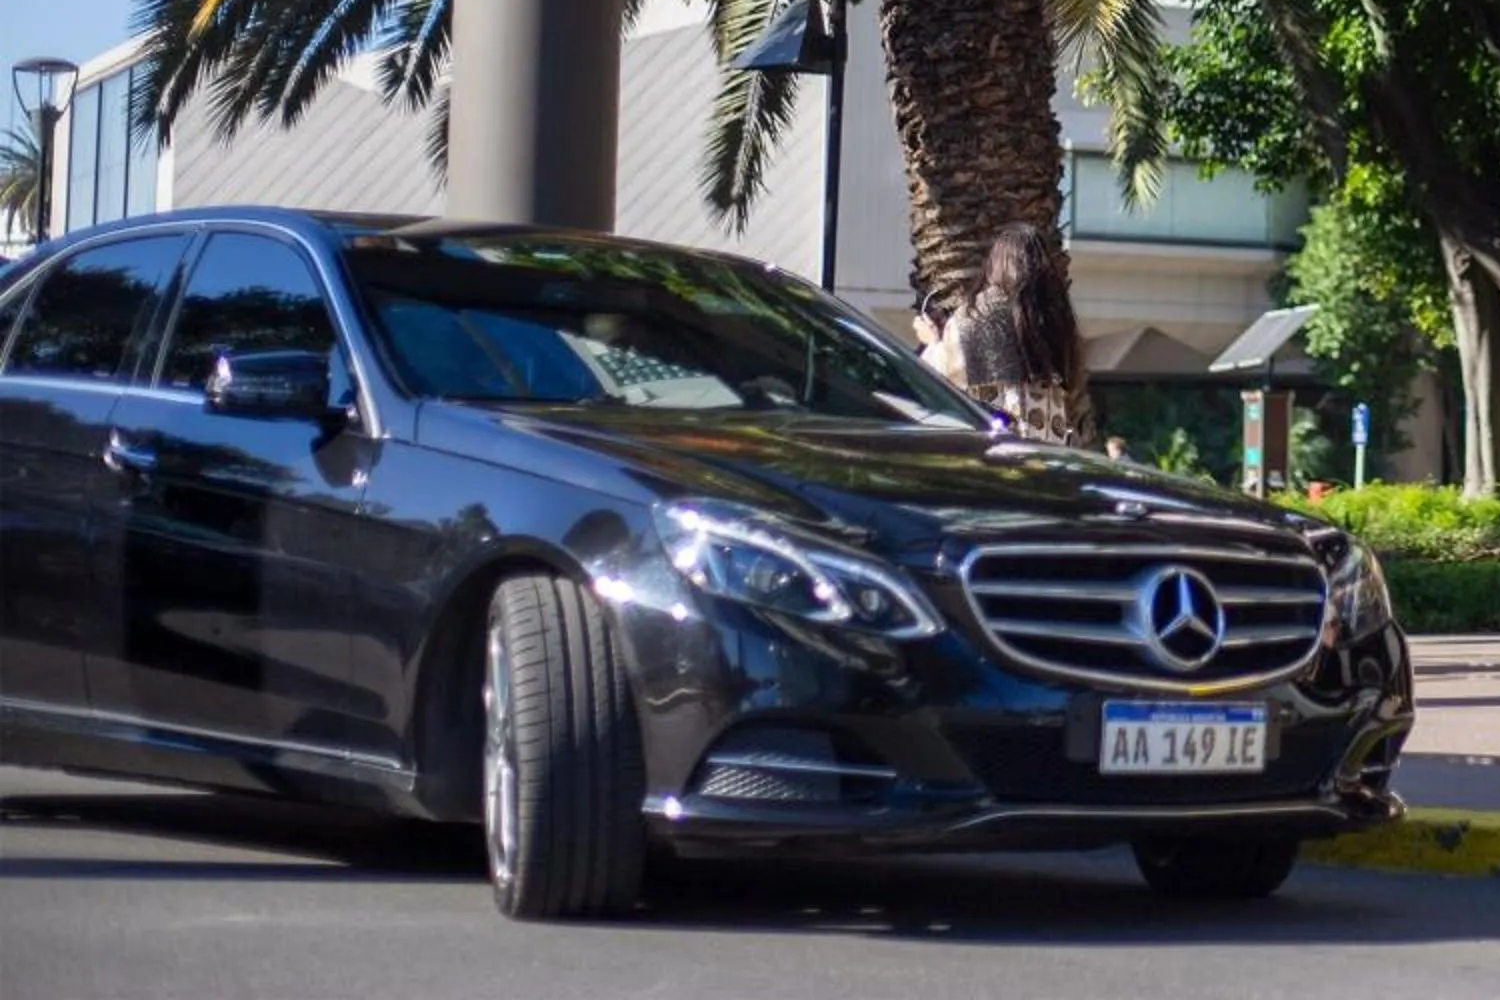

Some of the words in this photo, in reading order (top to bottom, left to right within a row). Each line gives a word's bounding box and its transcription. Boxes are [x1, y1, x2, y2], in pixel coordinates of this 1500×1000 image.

[1111, 726, 1149, 764] AA
[1162, 726, 1217, 764] 149
[1225, 727, 1257, 764] IE
